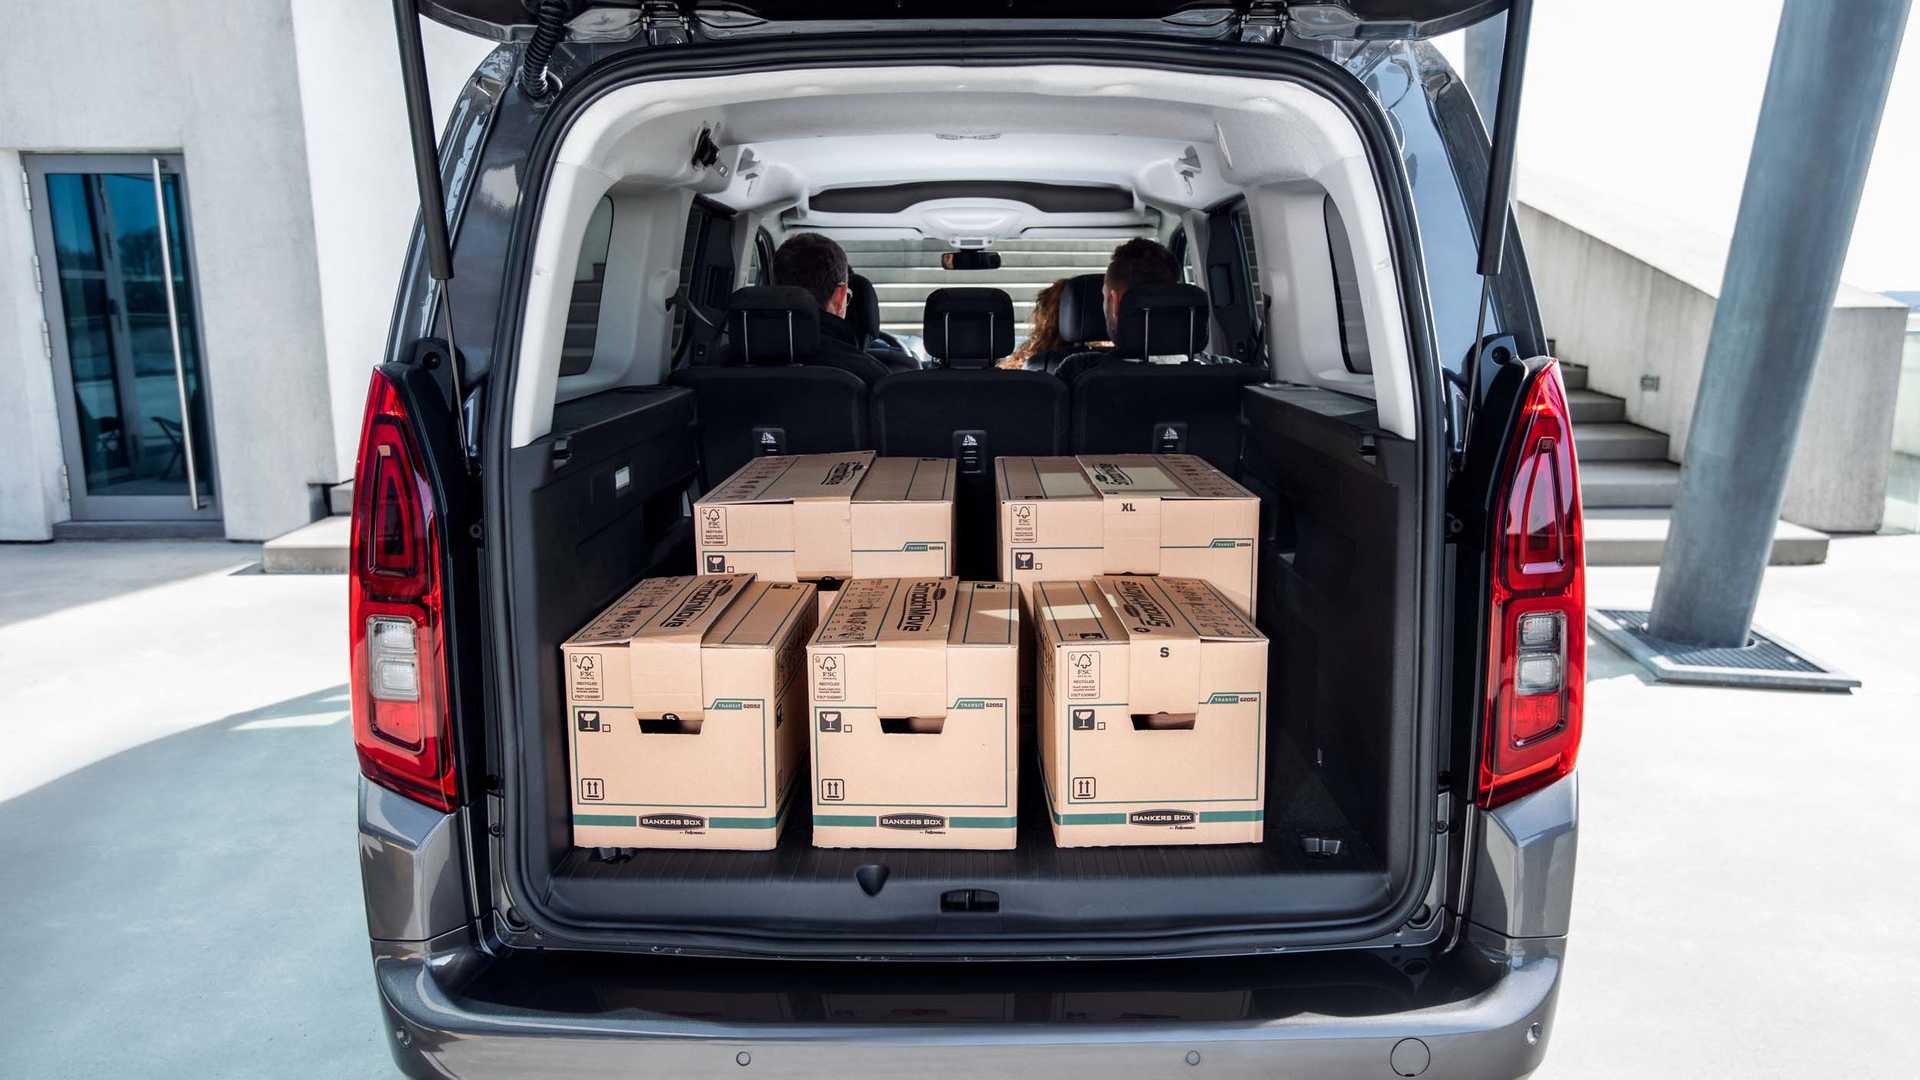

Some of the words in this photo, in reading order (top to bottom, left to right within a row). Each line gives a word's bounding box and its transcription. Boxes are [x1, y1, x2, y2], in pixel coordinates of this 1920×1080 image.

[1121, 503, 1136, 512] XL
[1160, 646, 1169, 658] S
[642, 818, 681, 826] BANKERS
[683, 818, 701, 826] BOX
[882, 818, 921, 826] BANKERS
[923, 818, 941, 826] BOX
[1132, 814, 1171, 822] BANKERS
[1173, 814, 1191, 822] BOX
